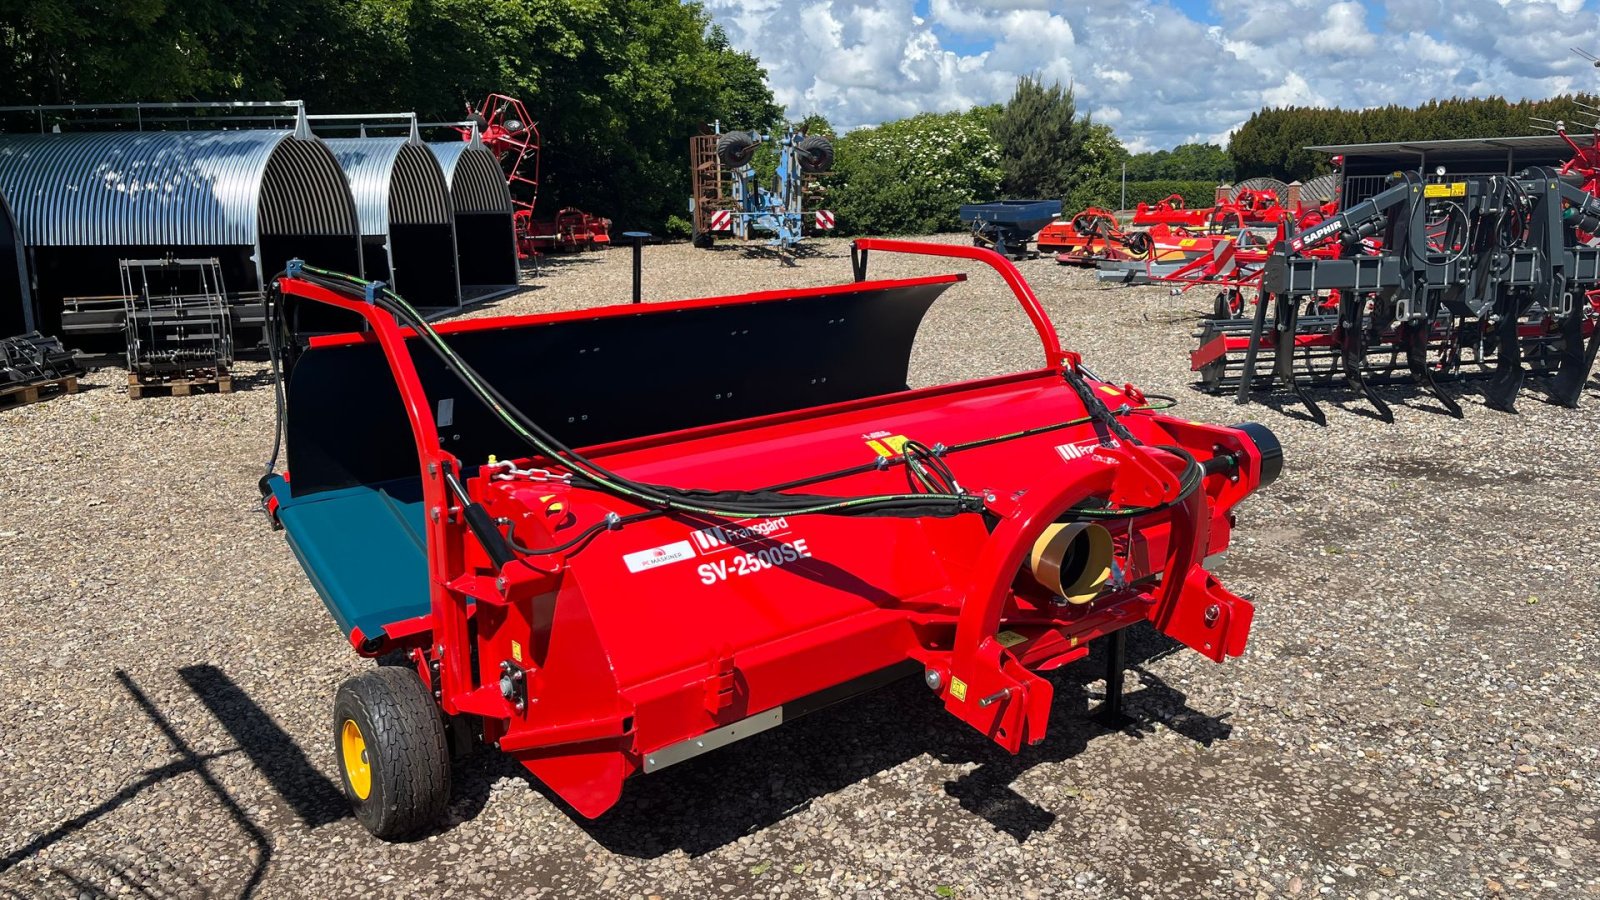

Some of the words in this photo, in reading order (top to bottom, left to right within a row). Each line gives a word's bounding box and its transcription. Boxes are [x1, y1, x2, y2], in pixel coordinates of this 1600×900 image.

[1303, 220, 1343, 244] SAPHIR
[725, 516, 789, 541] Fransgård
[697, 538, 812, 586] SV-2500SE
